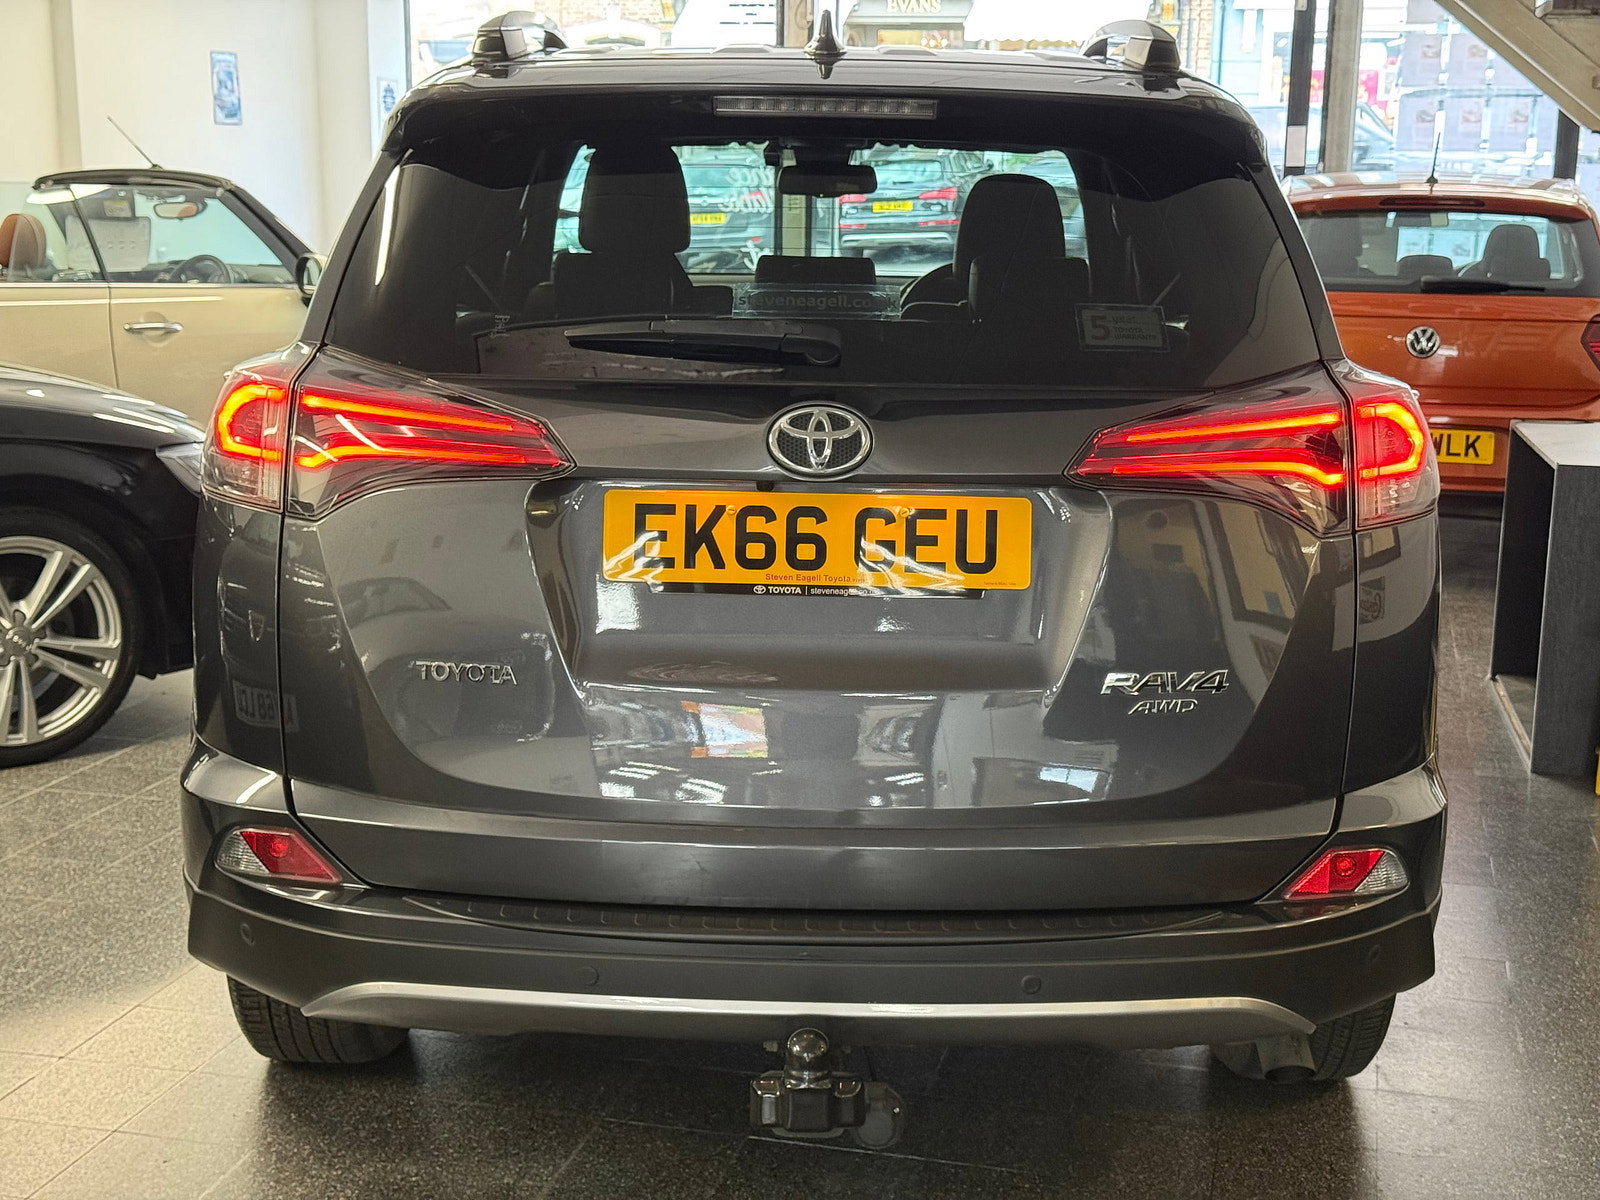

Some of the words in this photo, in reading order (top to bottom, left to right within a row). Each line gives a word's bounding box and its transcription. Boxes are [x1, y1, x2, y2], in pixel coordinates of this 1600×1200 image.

[886, 0, 942, 14] EVANS
[1090, 315, 1111, 341] 5
[633, 502, 829, 572] EK66
[853, 505, 998, 575] GEU
[765, 573, 794, 582] Steven
[795, 574, 821, 584] Eagell
[823, 574, 851, 584] Toyota
[767, 585, 802, 595] TOYOTA
[415, 660, 517, 685] TOYOTA
[1100, 669, 1230, 696] RAV4
[1127, 699, 1199, 715] AWD
